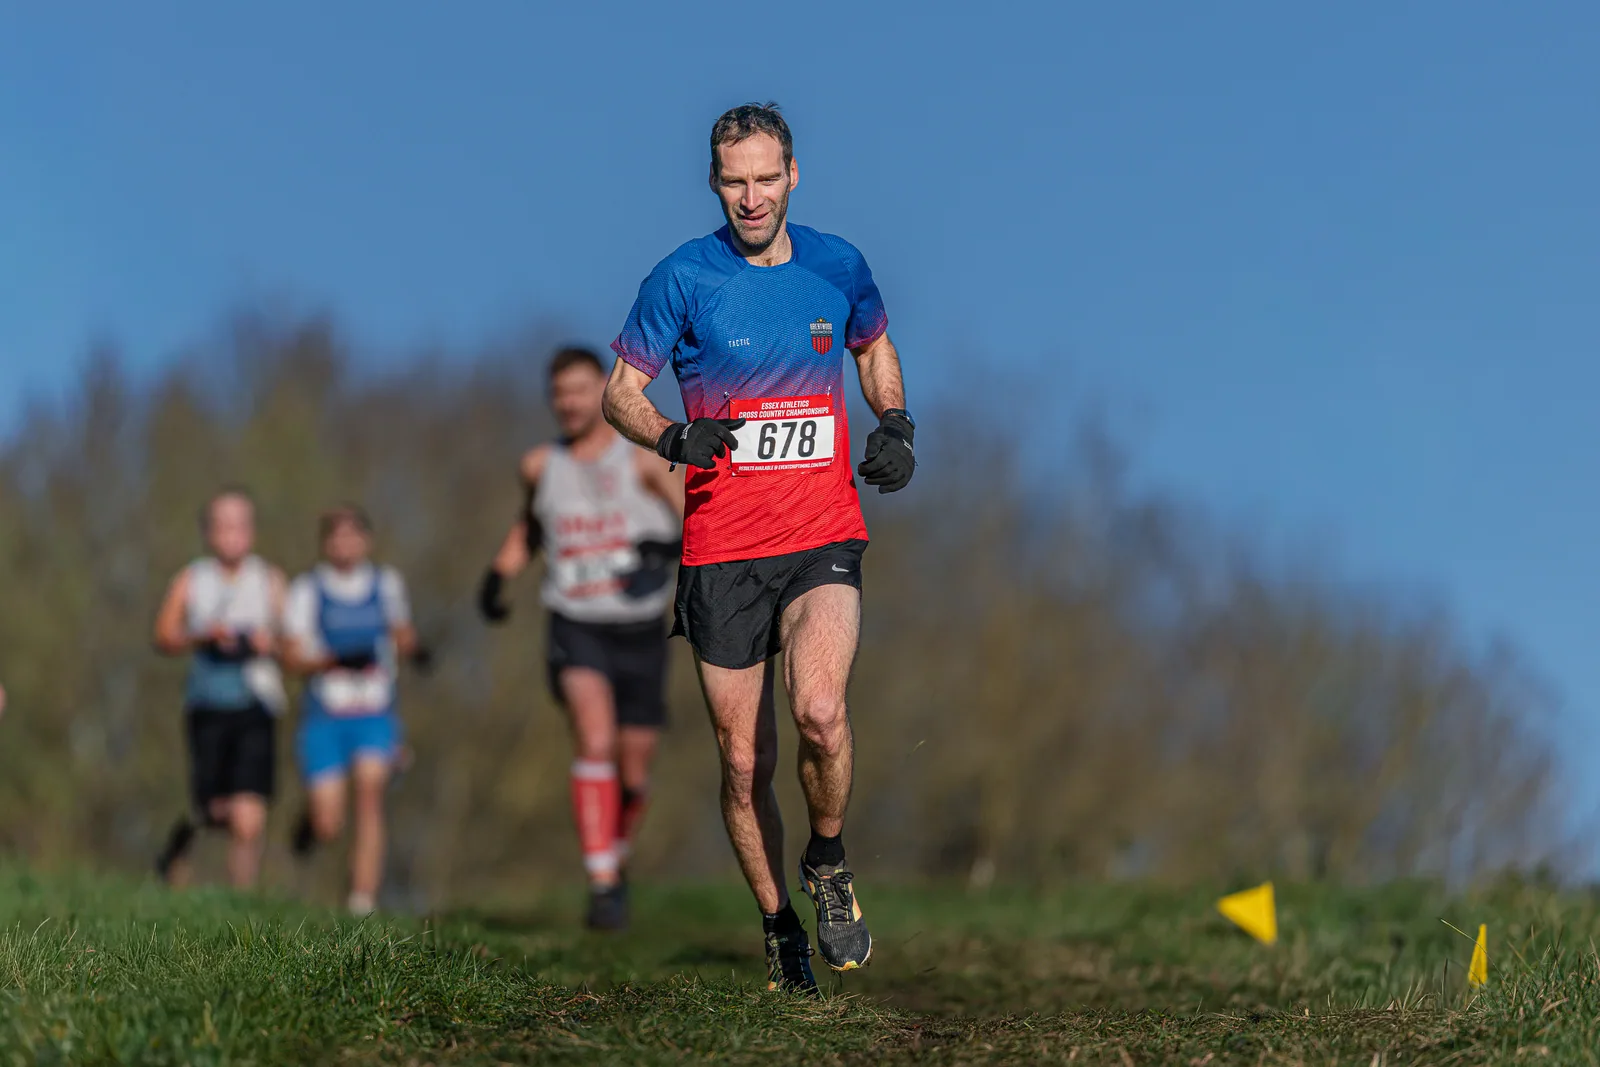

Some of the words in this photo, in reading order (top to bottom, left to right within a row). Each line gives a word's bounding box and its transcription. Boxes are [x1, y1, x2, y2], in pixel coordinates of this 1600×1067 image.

[729, 338, 750, 347] TACTIC
[761, 402, 779, 410] ESSEX
[780, 400, 809, 409] ATHLETICS
[759, 409, 785, 418] COUNTRY
[786, 406, 829, 416] CHAMPIONSHIPS
[757, 420, 817, 460] 678
